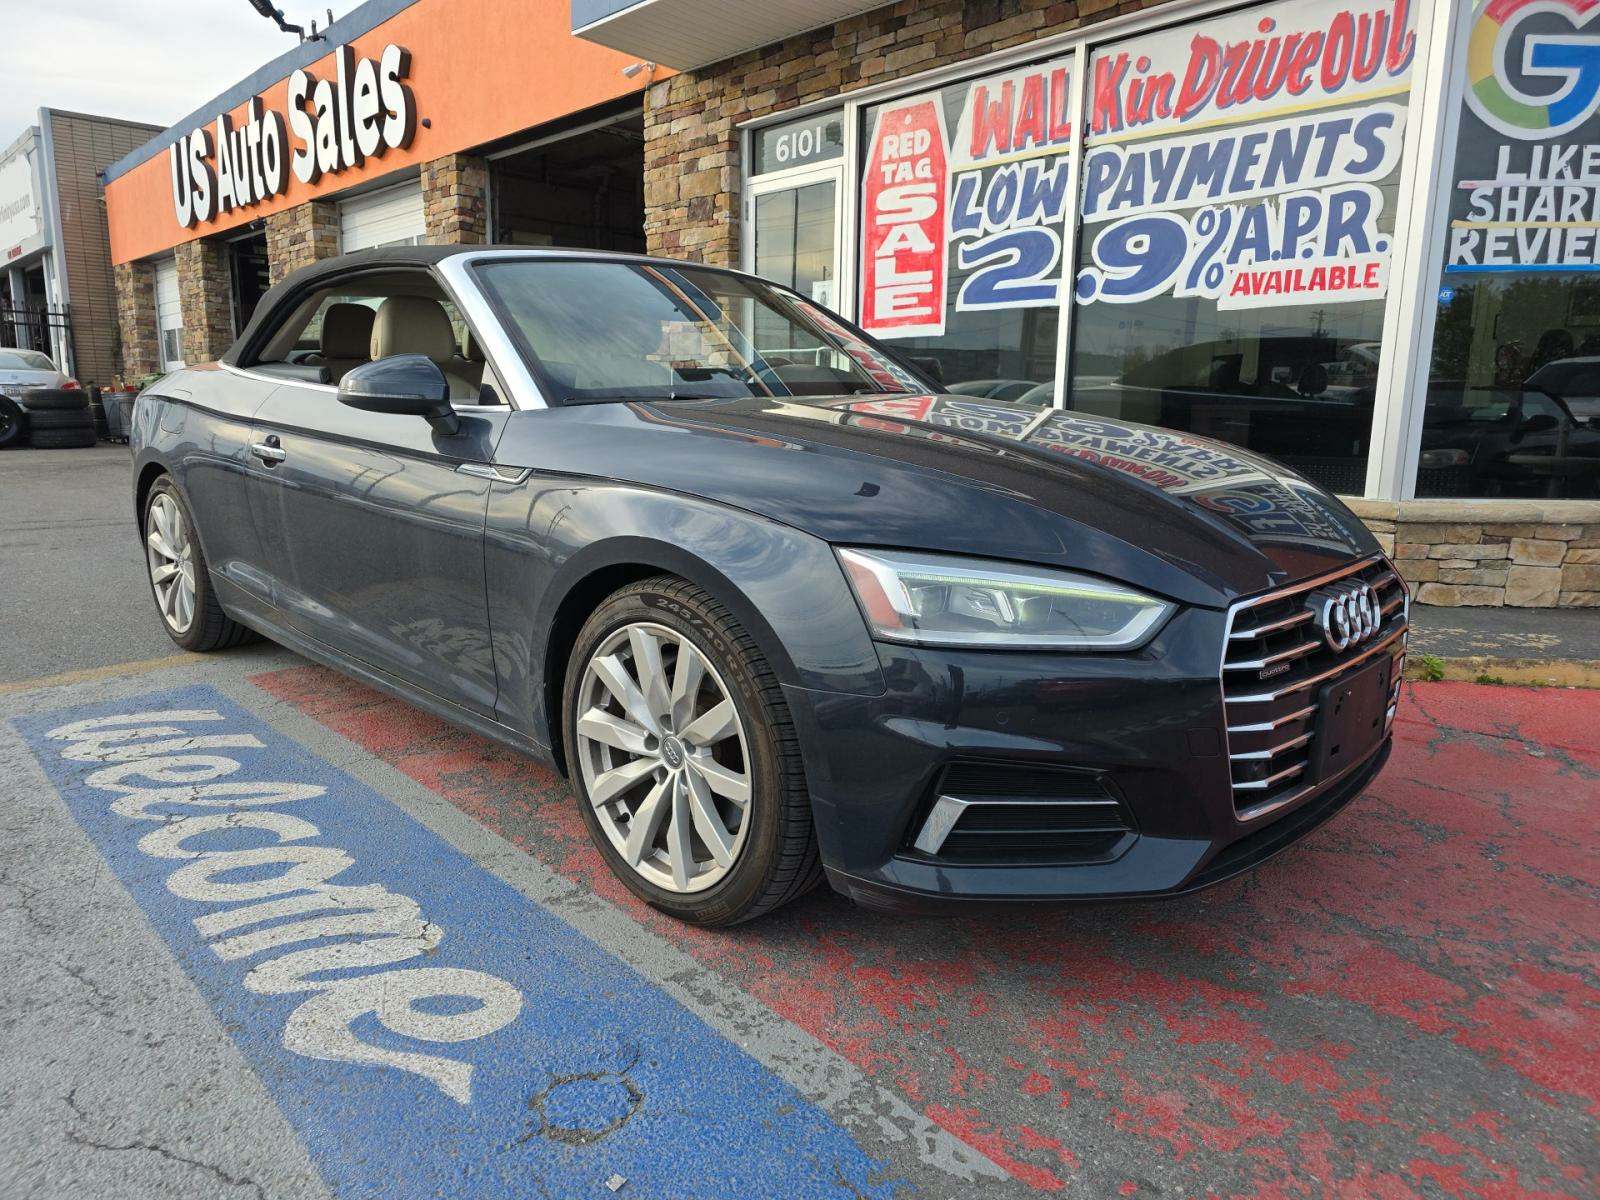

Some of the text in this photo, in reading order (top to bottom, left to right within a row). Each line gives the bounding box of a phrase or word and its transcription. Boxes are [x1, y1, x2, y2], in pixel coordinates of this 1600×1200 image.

[169, 42, 414, 229] US Auto Sales
[776, 126, 822, 163] 6101
[882, 128, 931, 161] RED
[880, 157, 933, 185] TAG
[950, 111, 1396, 237] LOW PAYMENTS
[1496, 144, 1600, 180] LIKE
[1467, 186, 1600, 222] SHAR
[1226, 190, 1389, 265] A.P.R.
[874, 182, 938, 320] SALE
[1449, 228, 1600, 265] REVIE
[1230, 263, 1381, 297] AVAILABLE
[45, 708, 523, 1104] Welcome
